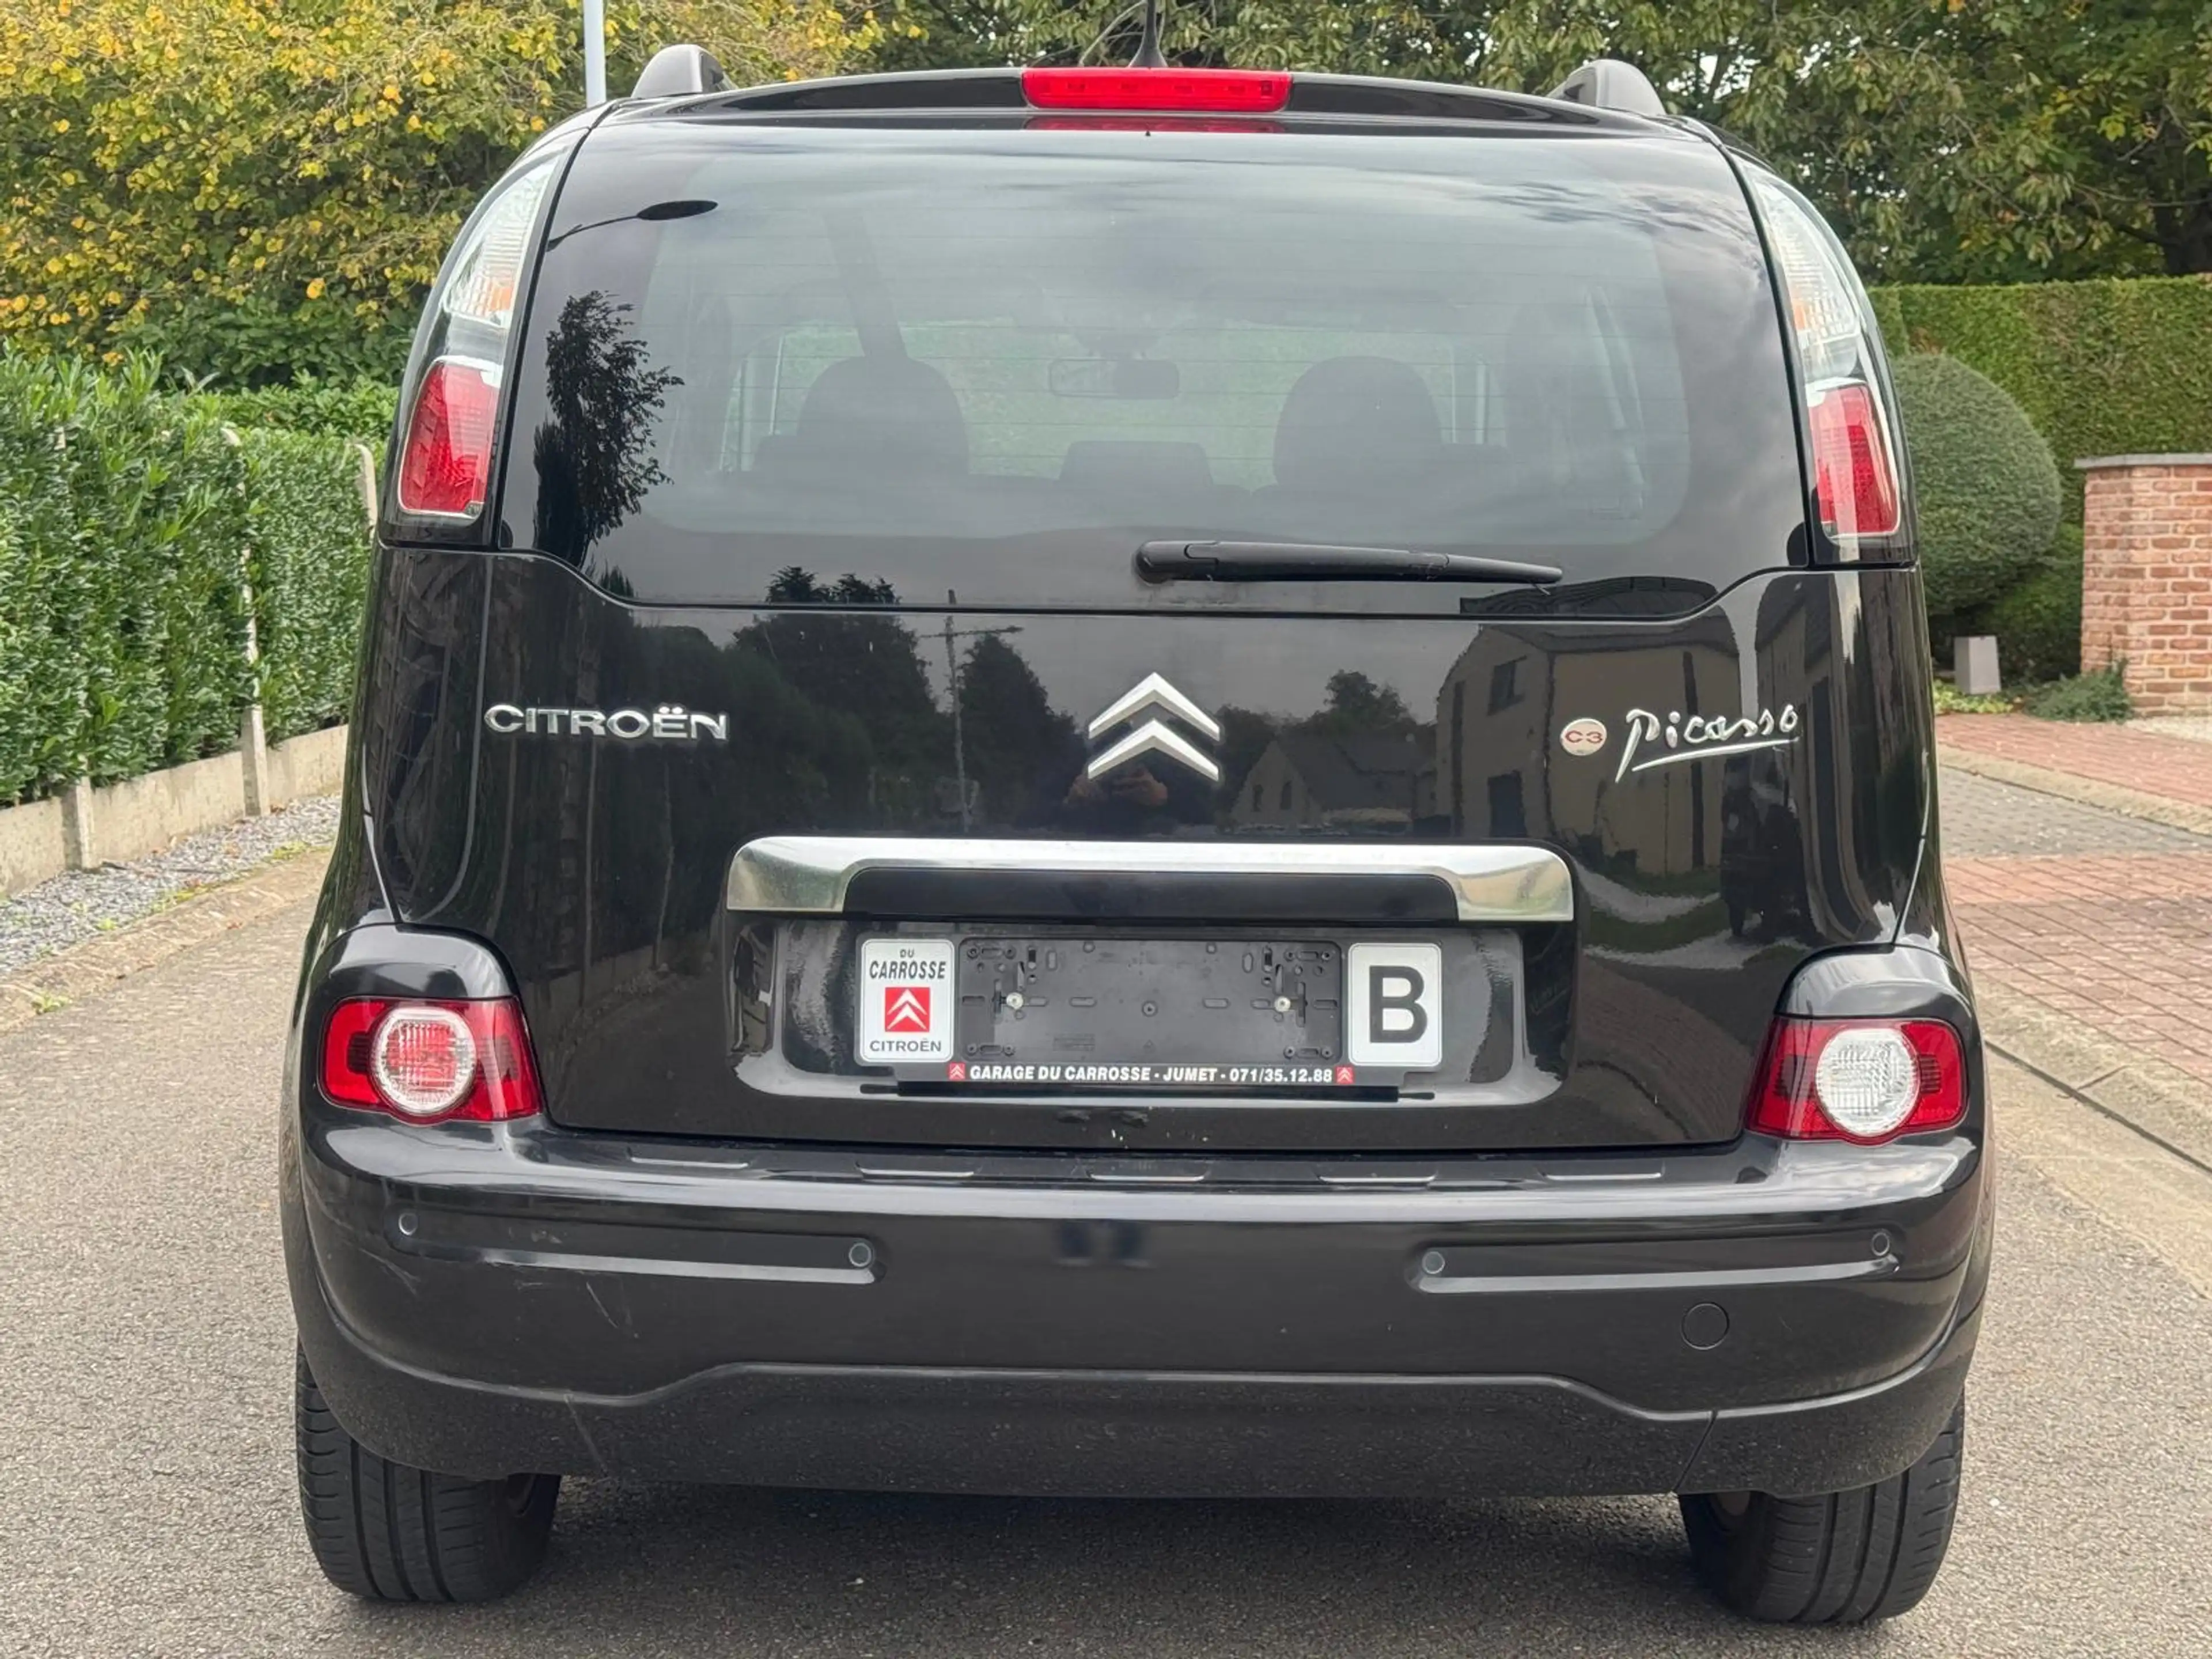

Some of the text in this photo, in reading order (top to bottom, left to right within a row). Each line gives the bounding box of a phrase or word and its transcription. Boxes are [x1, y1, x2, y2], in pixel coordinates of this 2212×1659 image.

[484, 703, 727, 740] CITROËN
[1565, 704, 1800, 783] C3 Picasso
[900, 949, 915, 957] DU
[869, 960, 946, 979] CARROSSE
[1369, 965, 1428, 1043] B
[970, 1065, 1035, 1080] GARAGE
[1038, 1066, 1061, 1080] DU
[1065, 1066, 1151, 1081] CARROSSE
[1162, 1067, 1218, 1082] JUMET
[1229, 1067, 1332, 1083] 071/35.12.88
